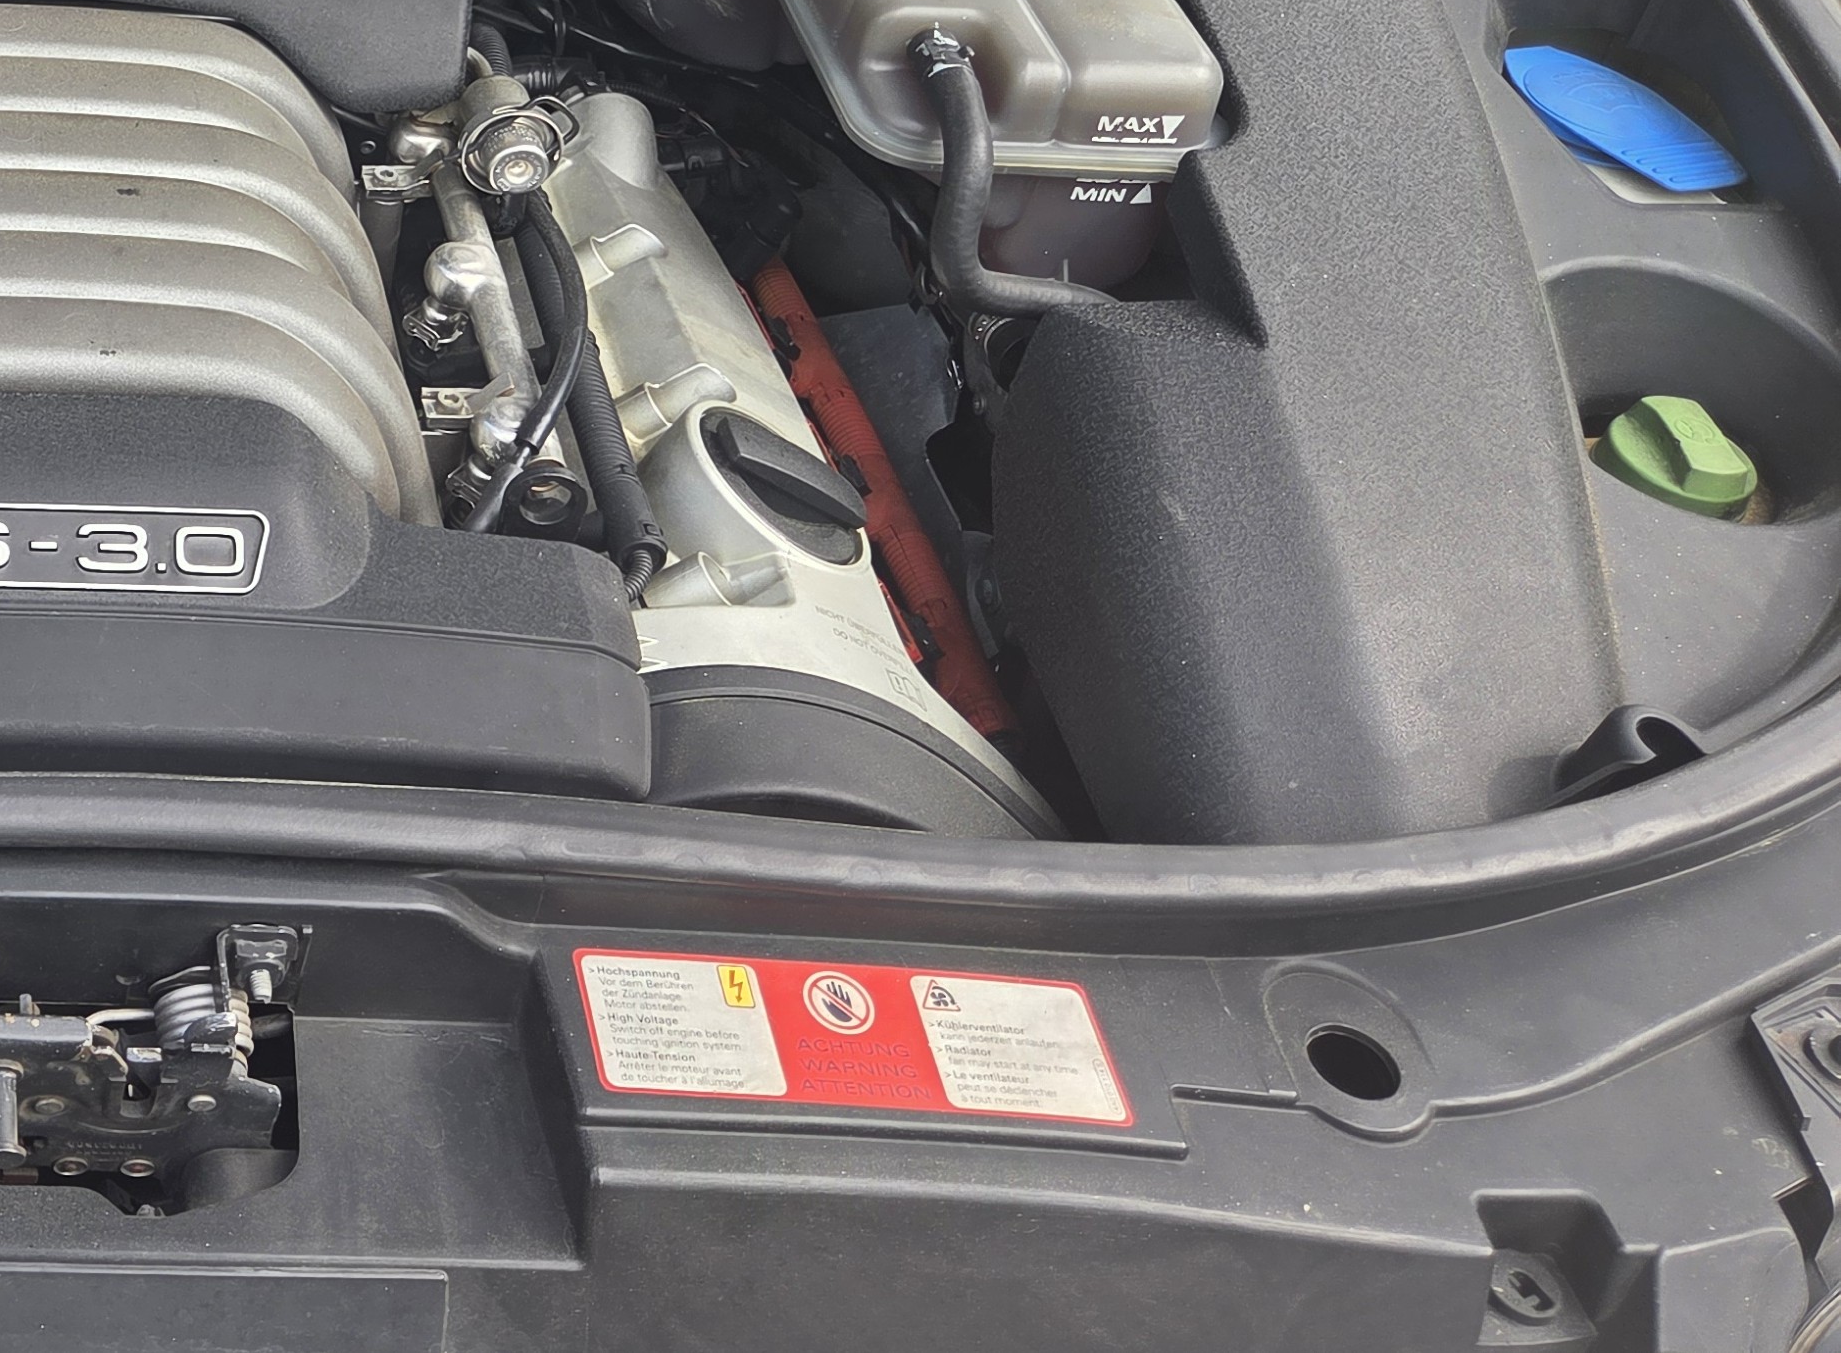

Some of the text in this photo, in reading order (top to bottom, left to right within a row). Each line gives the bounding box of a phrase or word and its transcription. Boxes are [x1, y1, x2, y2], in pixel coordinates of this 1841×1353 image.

[1097, 115, 1161, 133] MAX
[1070, 186, 1127, 204] MIN
[76, 522, 246, 576] 3.0
[815, 605, 845, 623] NICHT
[833, 627, 848, 640] DO
[849, 635, 869, 650] NOT
[596, 965, 681, 980] Hochspannung
[598, 977, 694, 990] Vor dem Berühren
[602, 988, 682, 1002] der Zündanlage
[604, 999, 636, 1009] Motor
[608, 1012, 679, 1026] High Voltage
[610, 1024, 740, 1040] Switch off engine before
[936, 1019, 1025, 1035] Kühlerventilator
[612, 1036, 659, 1049] touching
[661, 1038, 699, 1050] ignition
[940, 1032, 966, 1041] kann
[968, 1033, 1012, 1044] jederzeit
[797, 1038, 911, 1058] ACHTUNG
[945, 1045, 991, 1057] Radiator
[619, 1060, 742, 1076] Arrêter le moteur avant
[800, 1058, 918, 1078] WARNING
[948, 1056, 965, 1065] fan
[968, 1058, 990, 1069] may
[994, 1060, 1019, 1070] start
[1021, 1062, 1030, 1071] at
[1033, 1064, 1051, 1074] any
[621, 1072, 634, 1082] de
[637, 1073, 678, 1084] toucher
[952, 1070, 1029, 1084] Le ventilateur
[802, 1078, 931, 1100] ATTENTION
[958, 1083, 982, 1093] peut
[985, 1085, 996, 1093] se
[971, 1094, 991, 1104] tout
